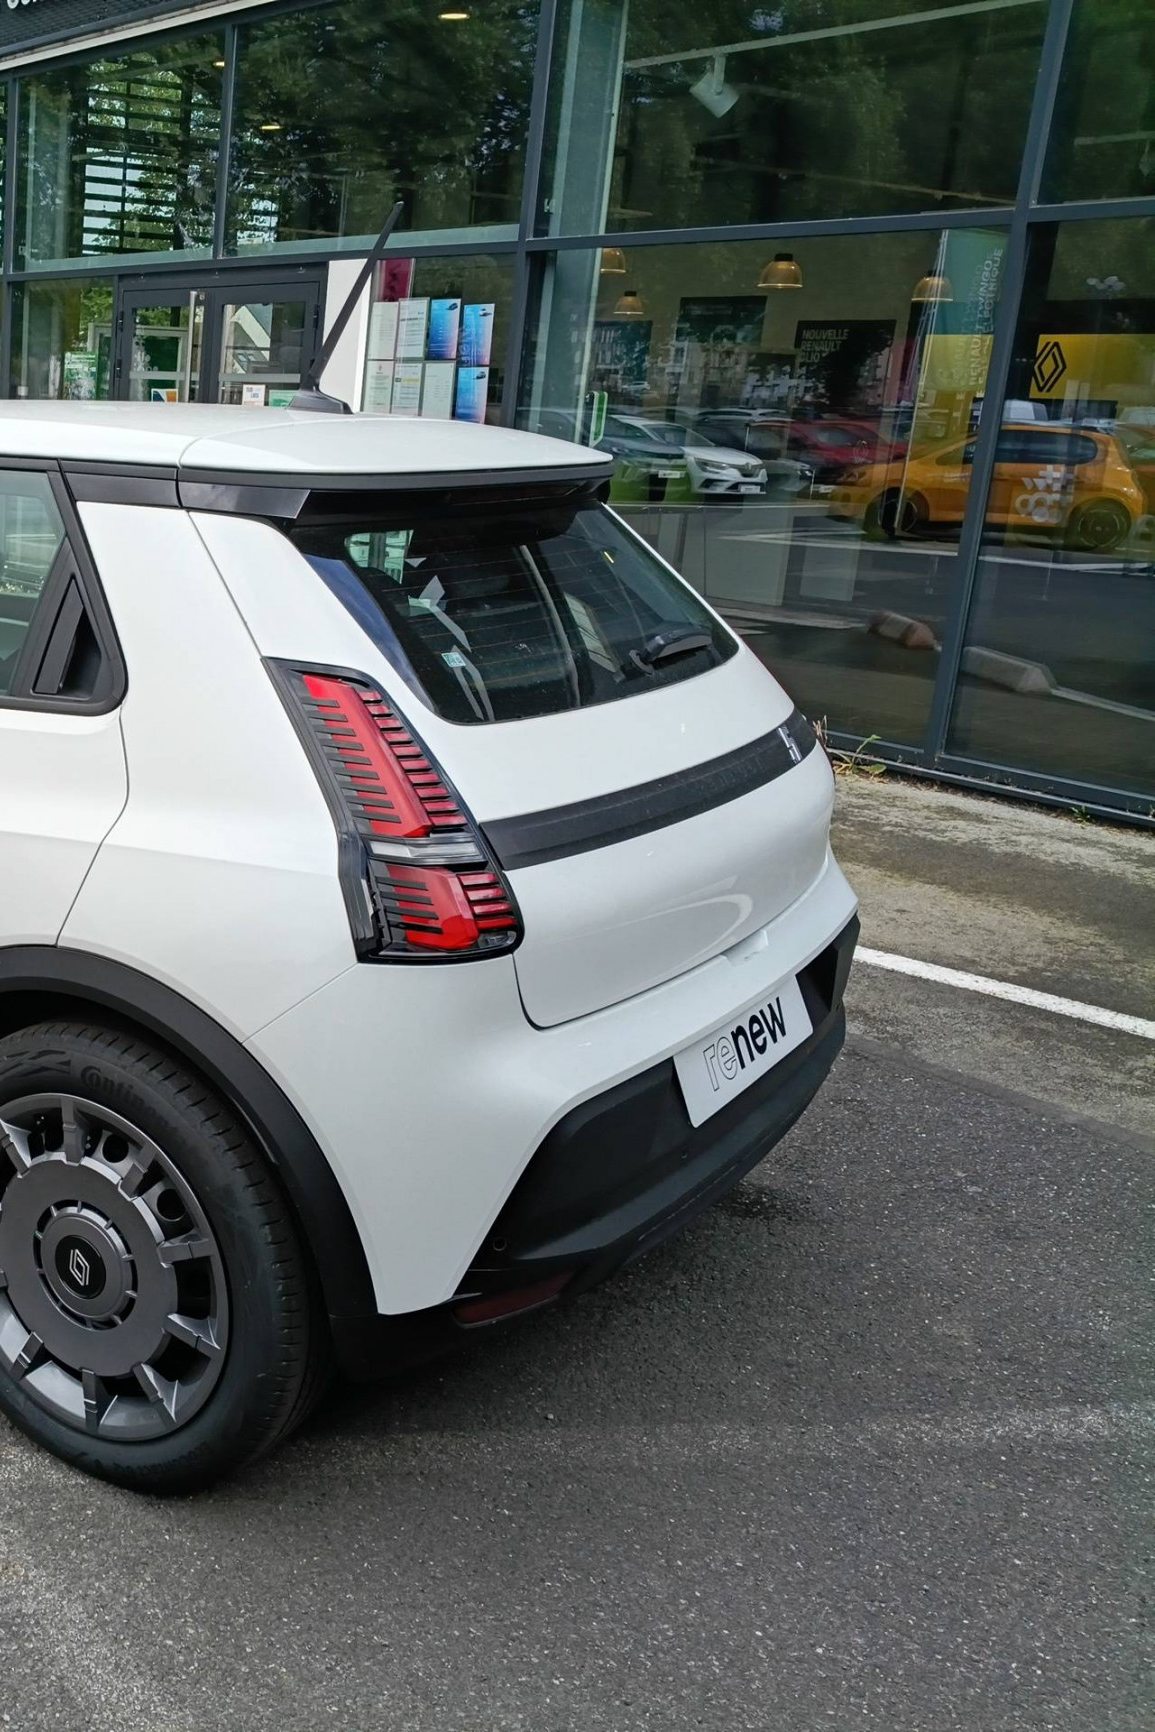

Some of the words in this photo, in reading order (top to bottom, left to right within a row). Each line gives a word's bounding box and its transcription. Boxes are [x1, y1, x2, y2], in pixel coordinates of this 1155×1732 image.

[802, 329, 849, 340] NOUVELLE
[800, 341, 842, 352] RENAULT
[703, 997, 786, 1092] renew
